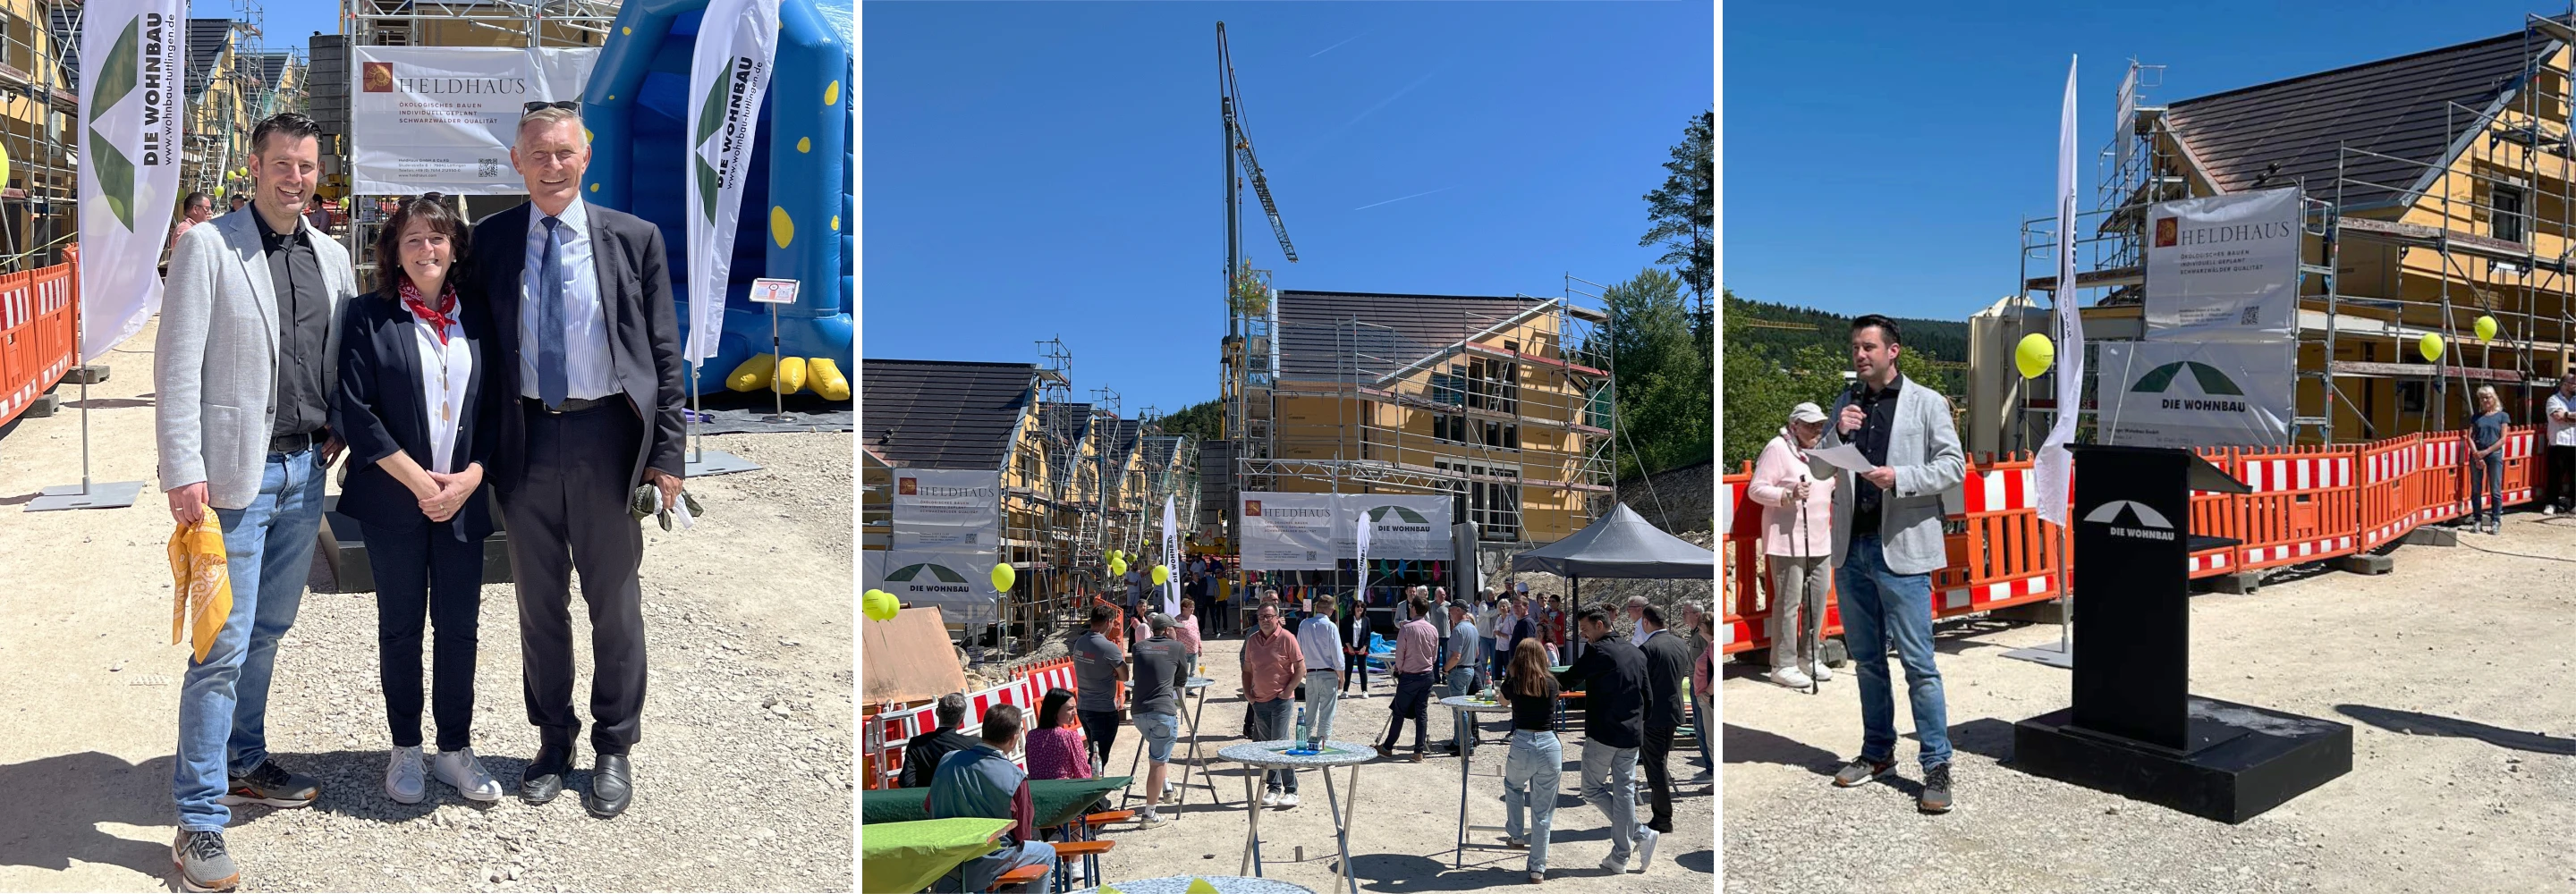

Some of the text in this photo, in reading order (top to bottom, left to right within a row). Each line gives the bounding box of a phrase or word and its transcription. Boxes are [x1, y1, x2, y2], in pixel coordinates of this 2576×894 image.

[144, 13, 163, 166] DIE WOHNBAU
[162, 13, 176, 165] www.wohnbau-tuttlingen.de
[399, 78, 526, 95] HELDHAUS
[717, 56, 753, 189] DIE WOHNBAU
[727, 62, 763, 190] www.wohnbau-tuttlingen.de
[2181, 221, 2290, 246] HELDHAUS
[2162, 399, 2246, 412] DIE WOHNBAU
[919, 486, 995, 498] HELDHAUS
[1264, 508, 1331, 518] HELDHAUS
[2110, 527, 2174, 540] DIE WOHNBAU
[1168, 535, 1176, 570] WOHNBAU
